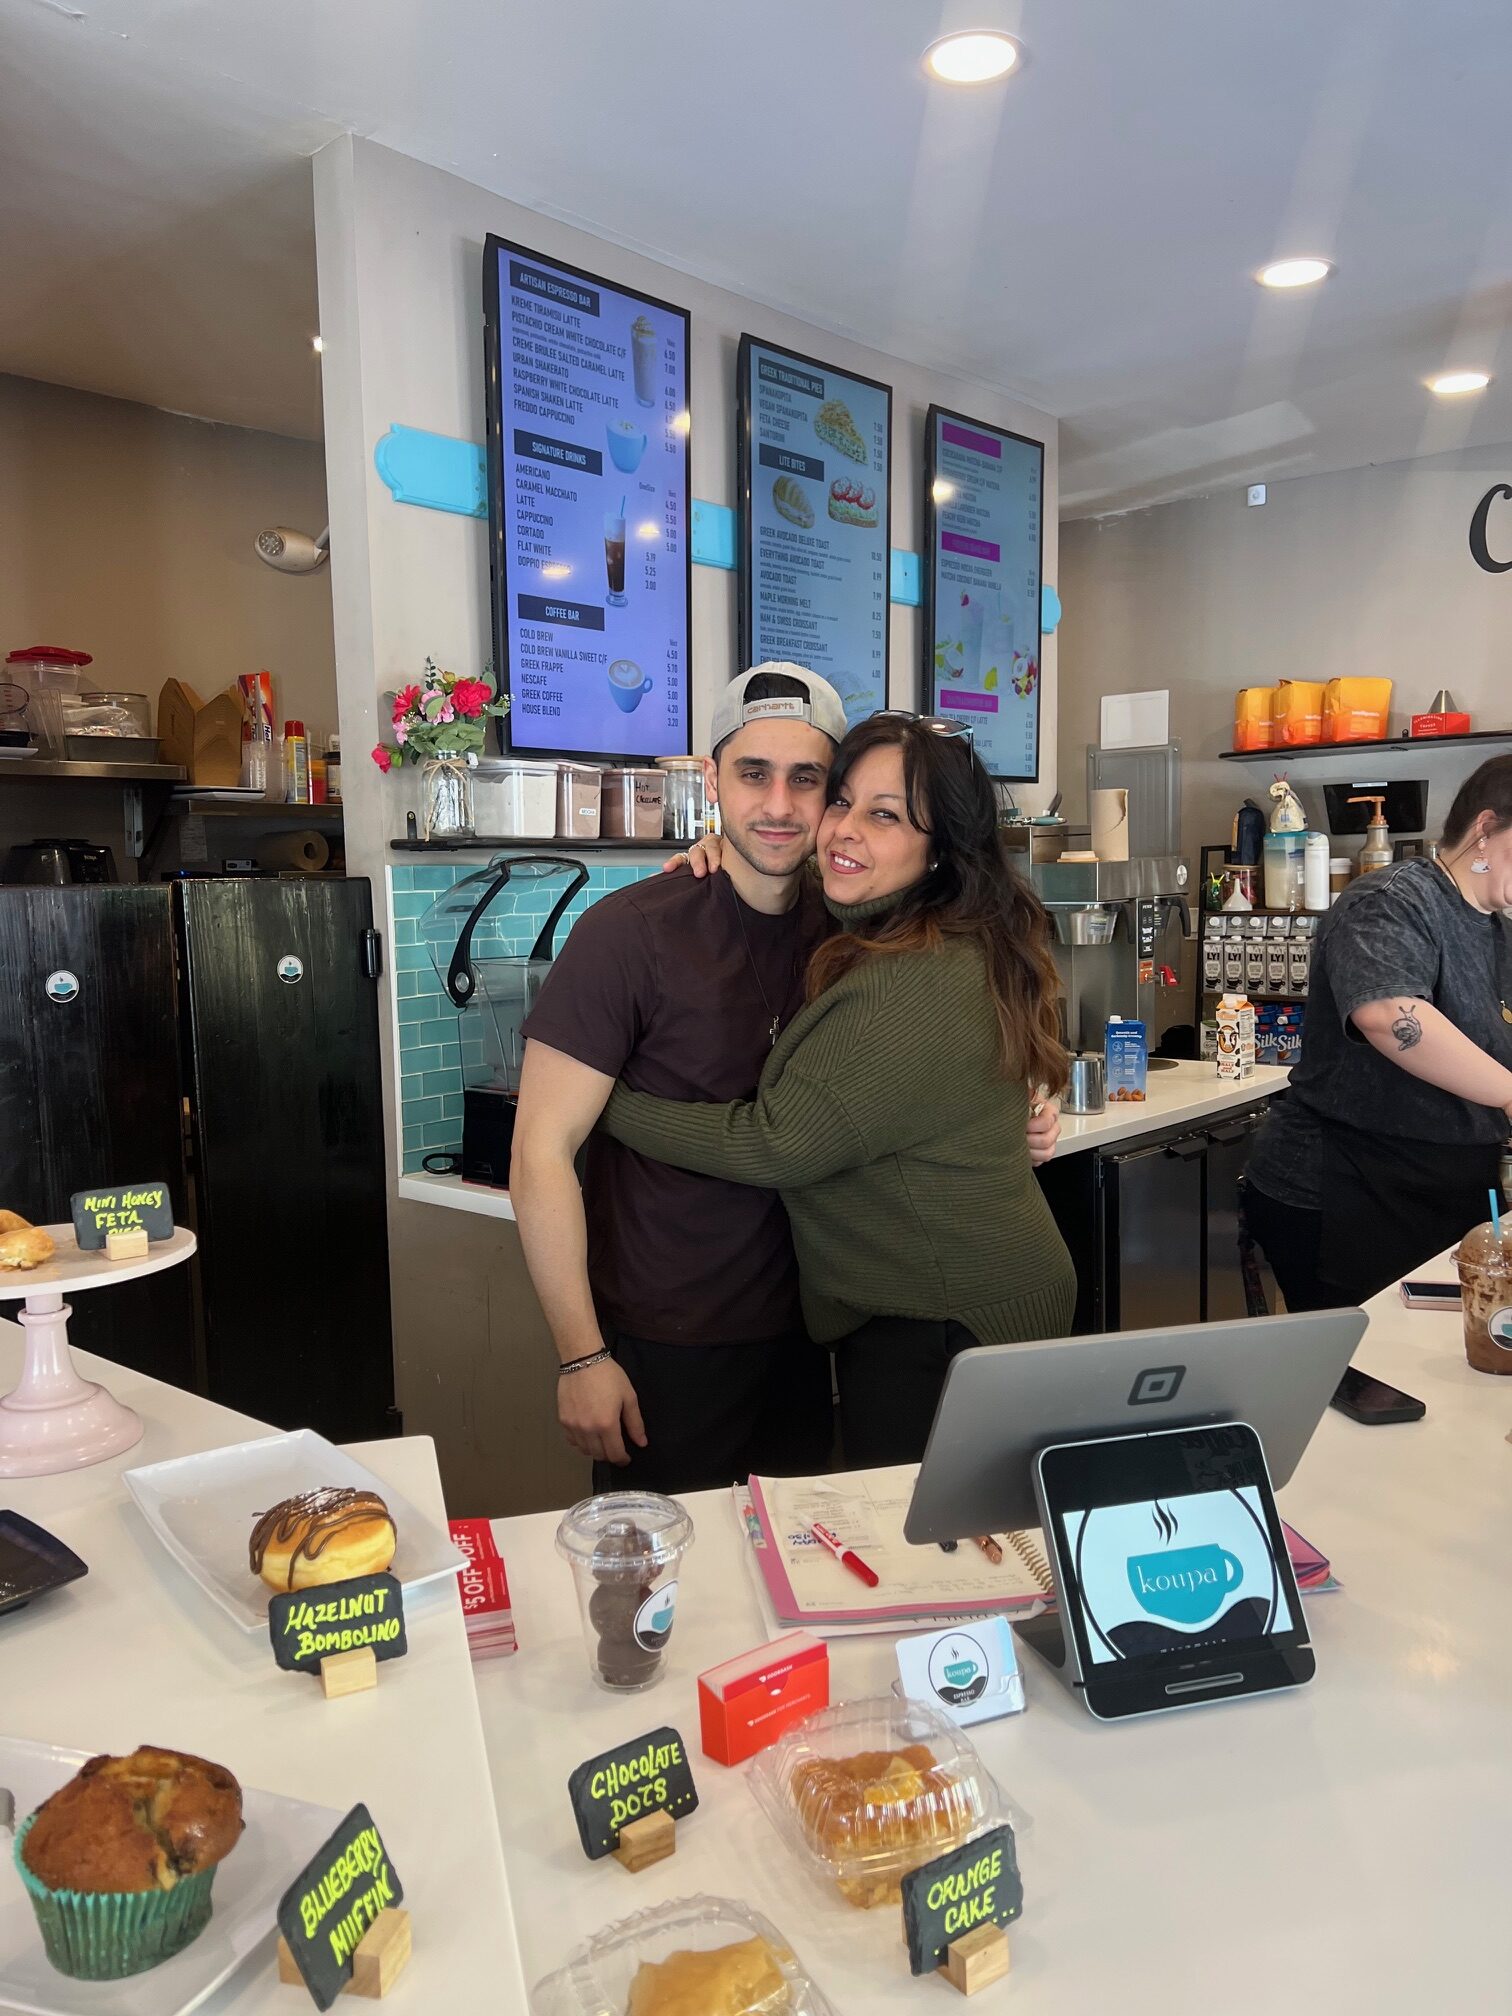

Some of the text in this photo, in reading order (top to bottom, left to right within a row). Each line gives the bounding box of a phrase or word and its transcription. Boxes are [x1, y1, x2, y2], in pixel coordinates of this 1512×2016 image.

[519, 272, 591, 307] ARTISAN ESPRESSO BAR
[511, 295, 581, 328] KREME TIRAMISU LATTE
[511, 311, 543, 331] PISTACHIO
[543, 323, 565, 339] CREAM
[565, 331, 584, 345] WHITE
[584, 336, 616, 356] CHOCOLATE
[512, 336, 534, 354] CREME
[534, 343, 557, 360] BRULEE
[558, 351, 580, 367] SALTED
[580, 358, 607, 376] CARAMEL
[607, 367, 625, 382] LATTE
[512, 352, 569, 379] URBAN SHAKERATO
[760, 364, 777, 379] GREEK
[513, 368, 619, 409] RASPBERRY WHITE CHOCOLATE LATTE
[513, 384, 583, 413] SPANISH SHAKEN LATTE
[513, 399, 575, 426] FREDDO CAPPUCCINO
[759, 413, 771, 424] FETA
[531, 441, 587, 466] SIGNATURE DRINKS
[515, 463, 551, 481] AMERICANO
[778, 454, 806, 472] LITE BITES
[515, 478, 578, 502] CARAMEL MACCHIATO
[516, 494, 535, 508] LATTE
[516, 509, 554, 527] CAPPUCCINO
[517, 524, 545, 540] CORTADO
[776, 529, 798, 543] AVOCADO
[815, 538, 830, 550] TOAST
[517, 540, 552, 556] FLAT WHITE
[517, 555, 540, 570] DOPPIO
[759, 548, 789, 562] EVERYTHING
[789, 553, 810, 567] AVOCADO
[810, 558, 825, 570] TOAST
[645, 565, 656, 577] 5.25
[760, 570, 782, 584] AVOCADO
[782, 573, 797, 585] TOAST
[760, 591, 777, 604] MAPLE
[800, 598, 811, 609] MELT
[545, 606, 580, 621] COFFEE BAR
[760, 613, 771, 624] HAM
[776, 616, 792, 627] SWISS
[793, 618, 817, 630] CROISSANT
[520, 628, 553, 642] COLD BREW
[760, 634, 828, 653] GREEK BREAKFAST CROISSANT
[520, 643, 608, 665] COLD BREW VANILLA SWEET C/F
[520, 659, 564, 673] GREEK FRAPPE
[521, 674, 547, 686] NESCAFE
[521, 689, 563, 702] GREEK COFFEE
[521, 704, 561, 717] HOUSE BLEND
[747, 703, 795, 714] carhartt
[636, 782, 649, 792] HOT
[1249, 954, 1263, 962] LY!
[1271, 954, 1284, 962] LY!
[1293, 955, 1306, 963] LY!
[1255, 1033, 1278, 1050] Silk
[1277, 1034, 1302, 1052] Silk
[84, 1190, 162, 1212] MINI HONEY
[95, 1210, 143, 1229] FETA
[452, 1533, 476, 1556] OFF
[462, 1567, 485, 1596] OFF
[1136, 1564, 1218, 1595] koupa
[284, 1588, 389, 1635] HAZELNUT
[294, 1617, 400, 1661] BOMBOLINO
[946, 1666, 971, 1679] koupa
[953, 1689, 975, 1700] ESPRESSO
[591, 1742, 682, 1800] CHOCOLATE
[300, 1826, 383, 1939] BLUEBERRY
[927, 1849, 1002, 1911] ORANGE
[329, 1863, 394, 1967] MUFFIN
[945, 1886, 996, 1934] CAKE
